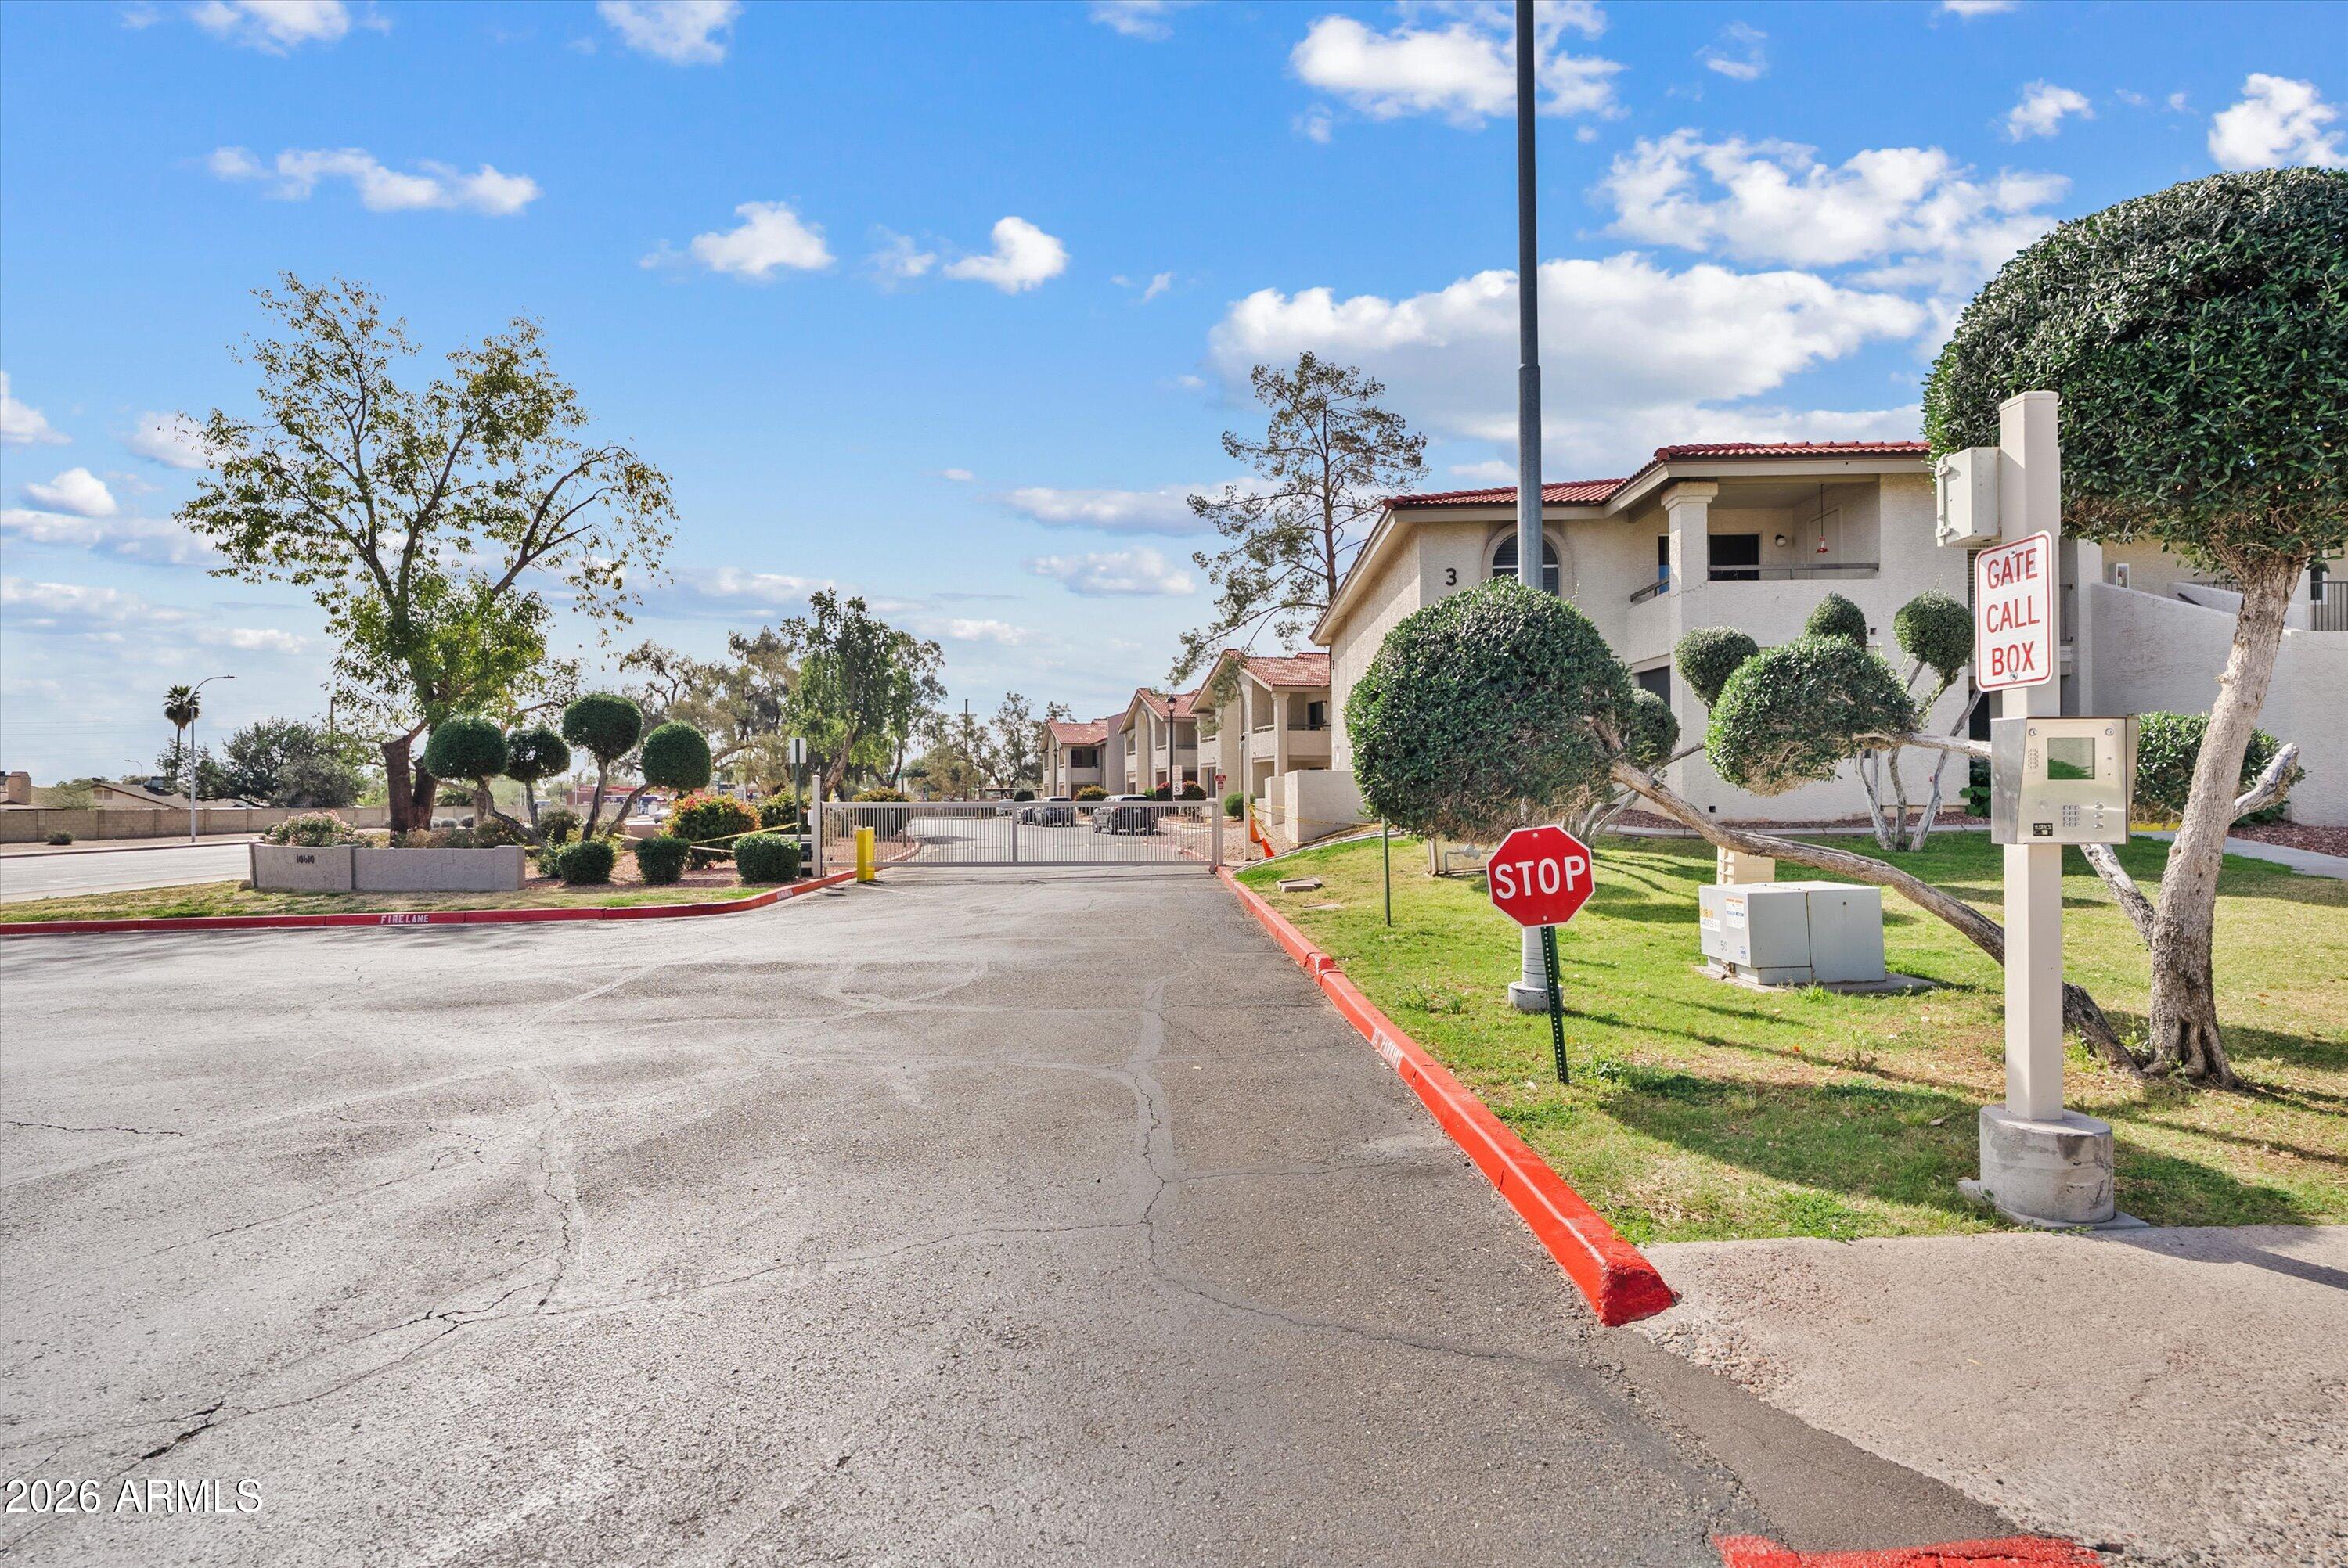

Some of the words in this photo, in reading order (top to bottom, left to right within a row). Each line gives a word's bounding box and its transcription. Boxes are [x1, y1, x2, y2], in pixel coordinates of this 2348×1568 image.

[1445, 567, 1457, 586] 3
[1987, 548, 2038, 590] GATE
[1986, 595, 2040, 634] CALL
[1992, 641, 2035, 678] BOX
[1494, 855, 1586, 900] STOP
[380, 915, 404, 924] FIRE
[405, 914, 429, 923] LANE
